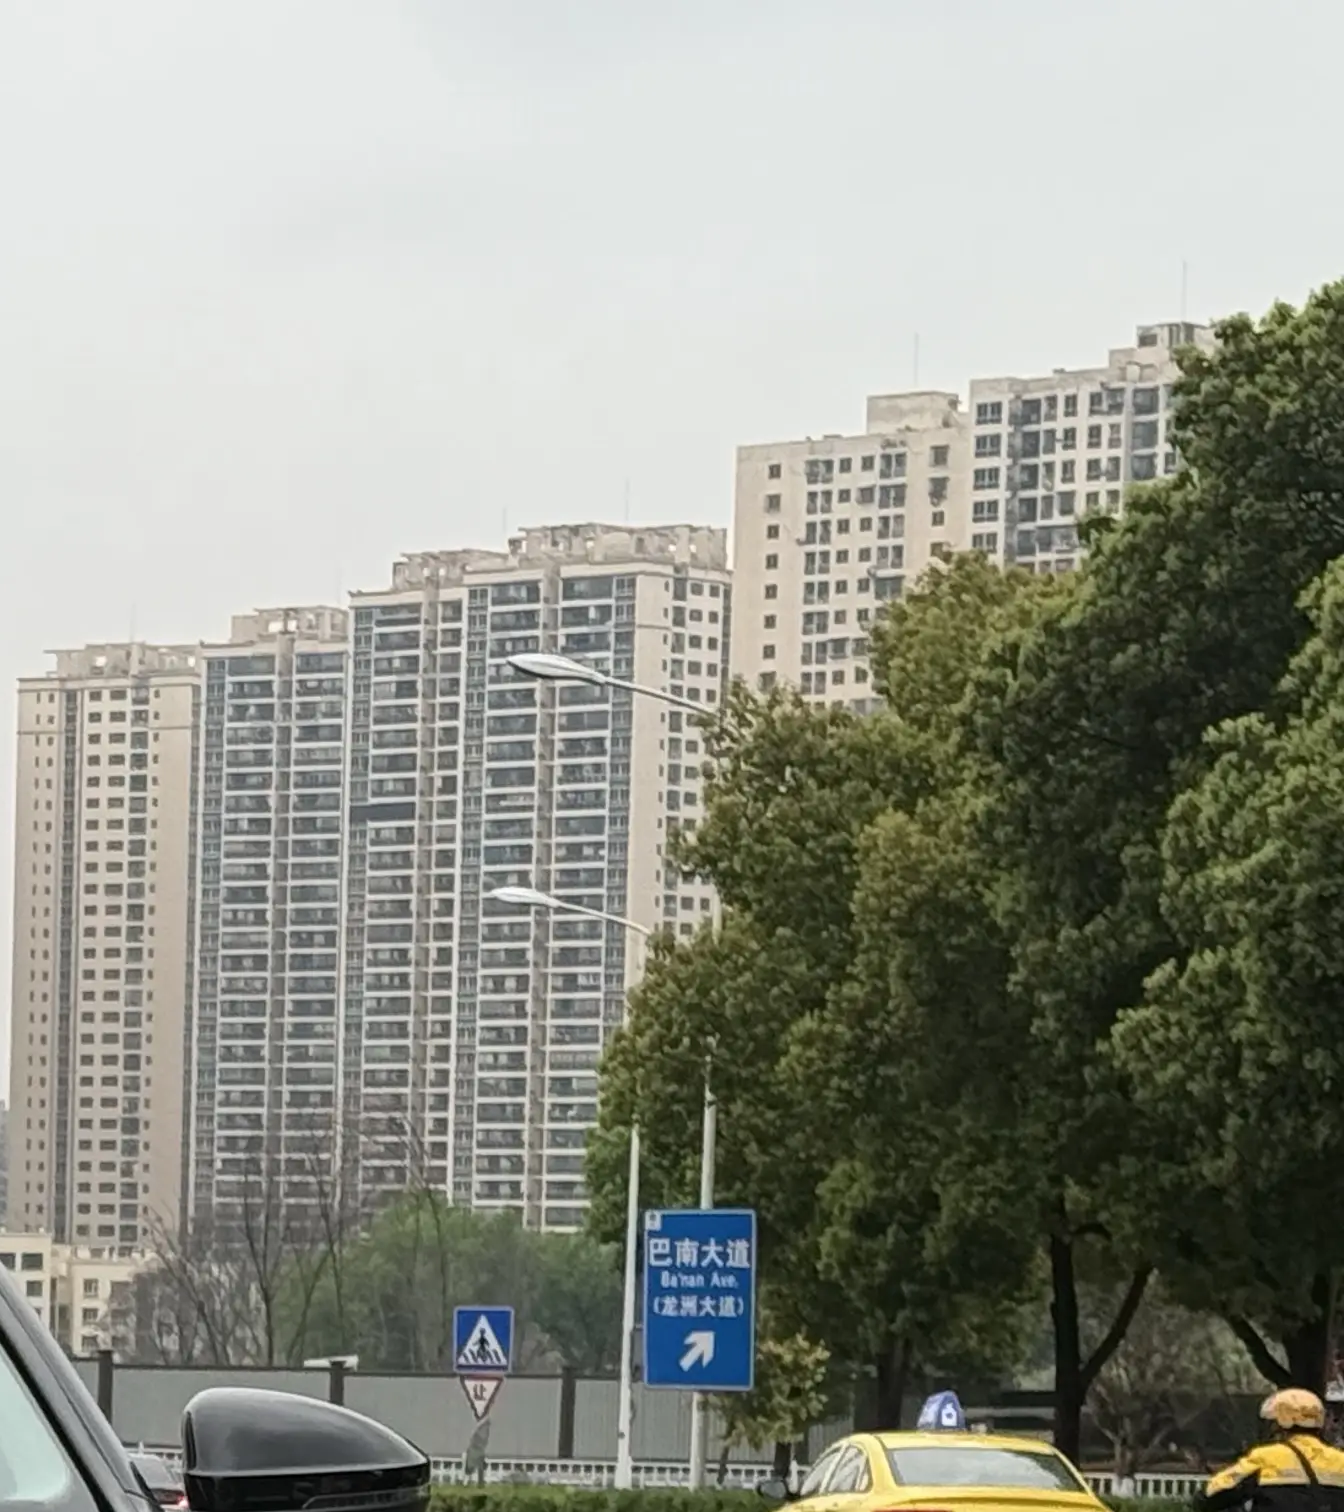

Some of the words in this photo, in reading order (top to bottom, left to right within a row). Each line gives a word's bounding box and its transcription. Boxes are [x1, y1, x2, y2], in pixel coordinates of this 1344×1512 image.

[649, 1237, 751, 1269] 巴南大道
[661, 1270, 705, 1289] Ba'nan
[711, 1271, 740, 1290] Ave.
[472, 1383, 487, 1401] 让
